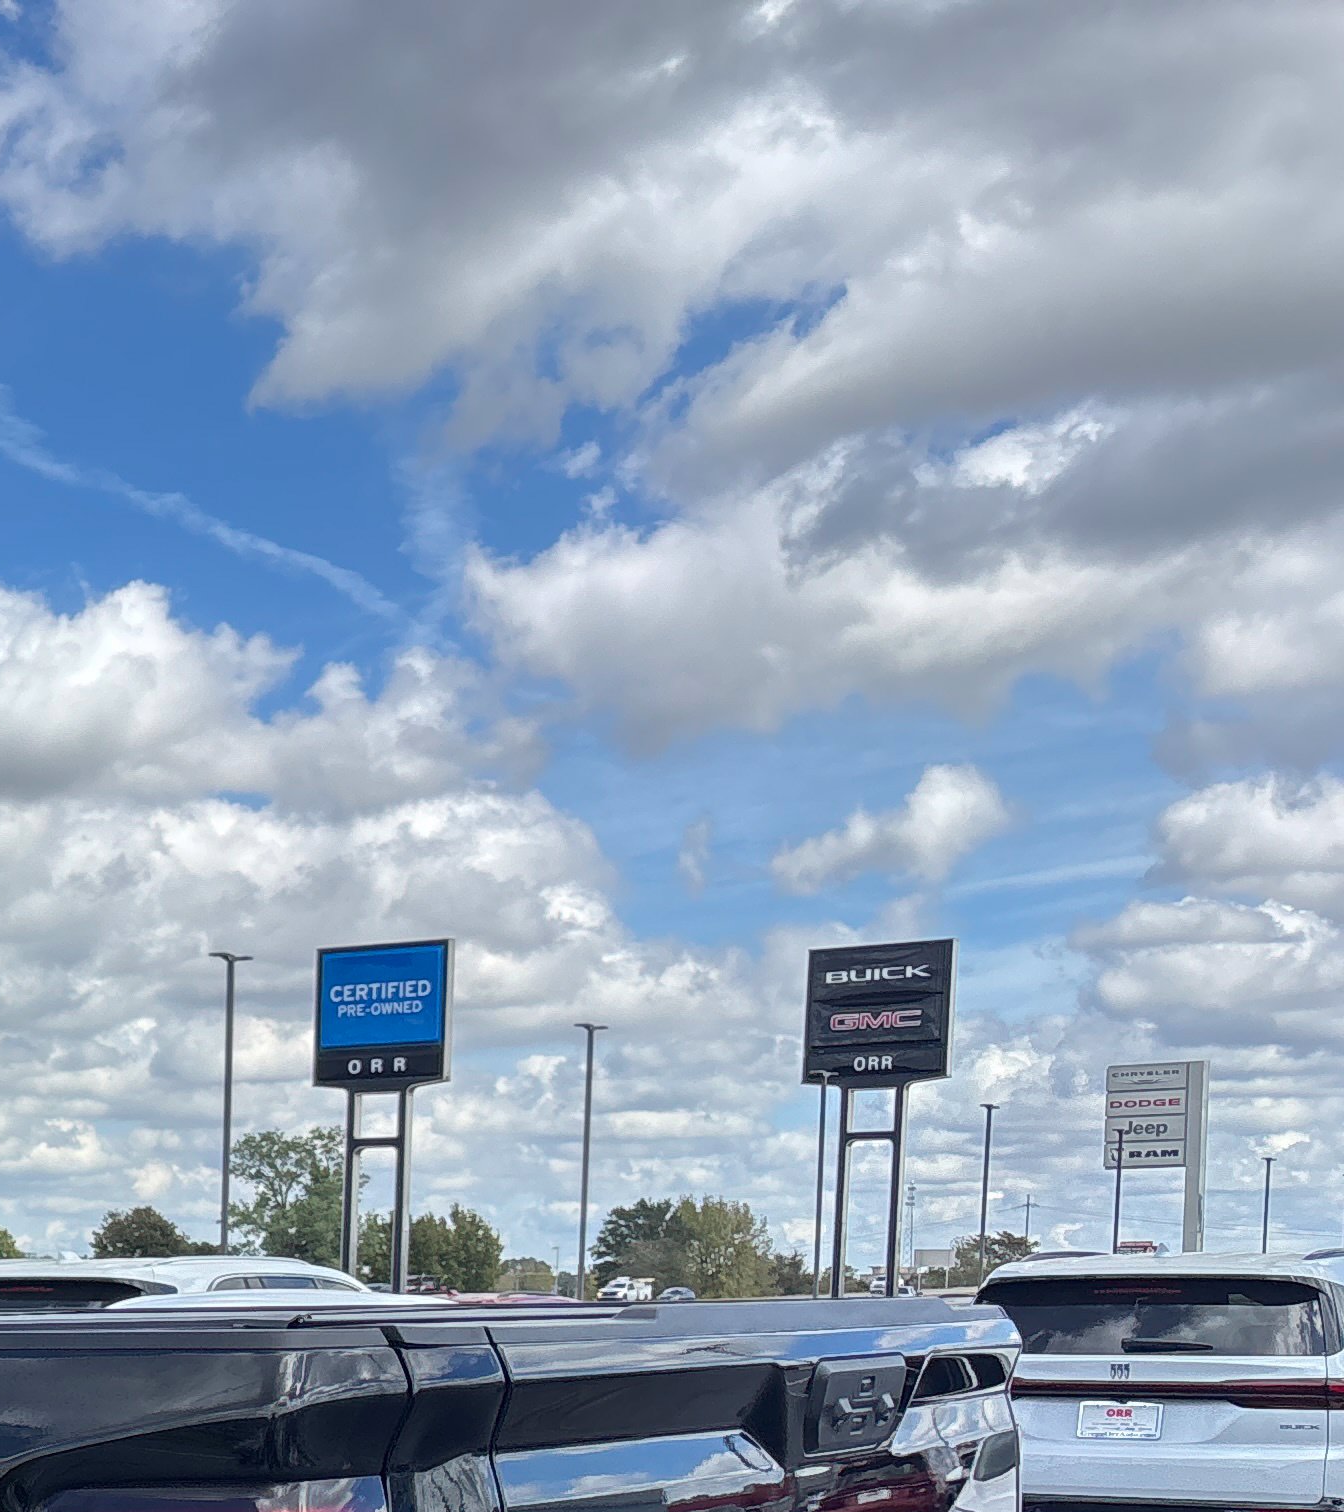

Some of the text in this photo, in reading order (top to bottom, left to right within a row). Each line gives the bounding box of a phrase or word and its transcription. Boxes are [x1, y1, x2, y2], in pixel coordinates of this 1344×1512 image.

[825, 964, 932, 984] BUICK
[329, 979, 432, 1003] CERTIFIED
[337, 1000, 423, 1018] PRE-OWNED
[830, 1009, 923, 1031] GMC
[853, 1055, 893, 1072] ORR
[1112, 1069, 1180, 1078] CHRYSLER
[1110, 1098, 1181, 1109] DODGE
[1124, 1121, 1169, 1137] Jeep
[1128, 1149, 1180, 1159] RAM
[1105, 1408, 1133, 1418] ORR
